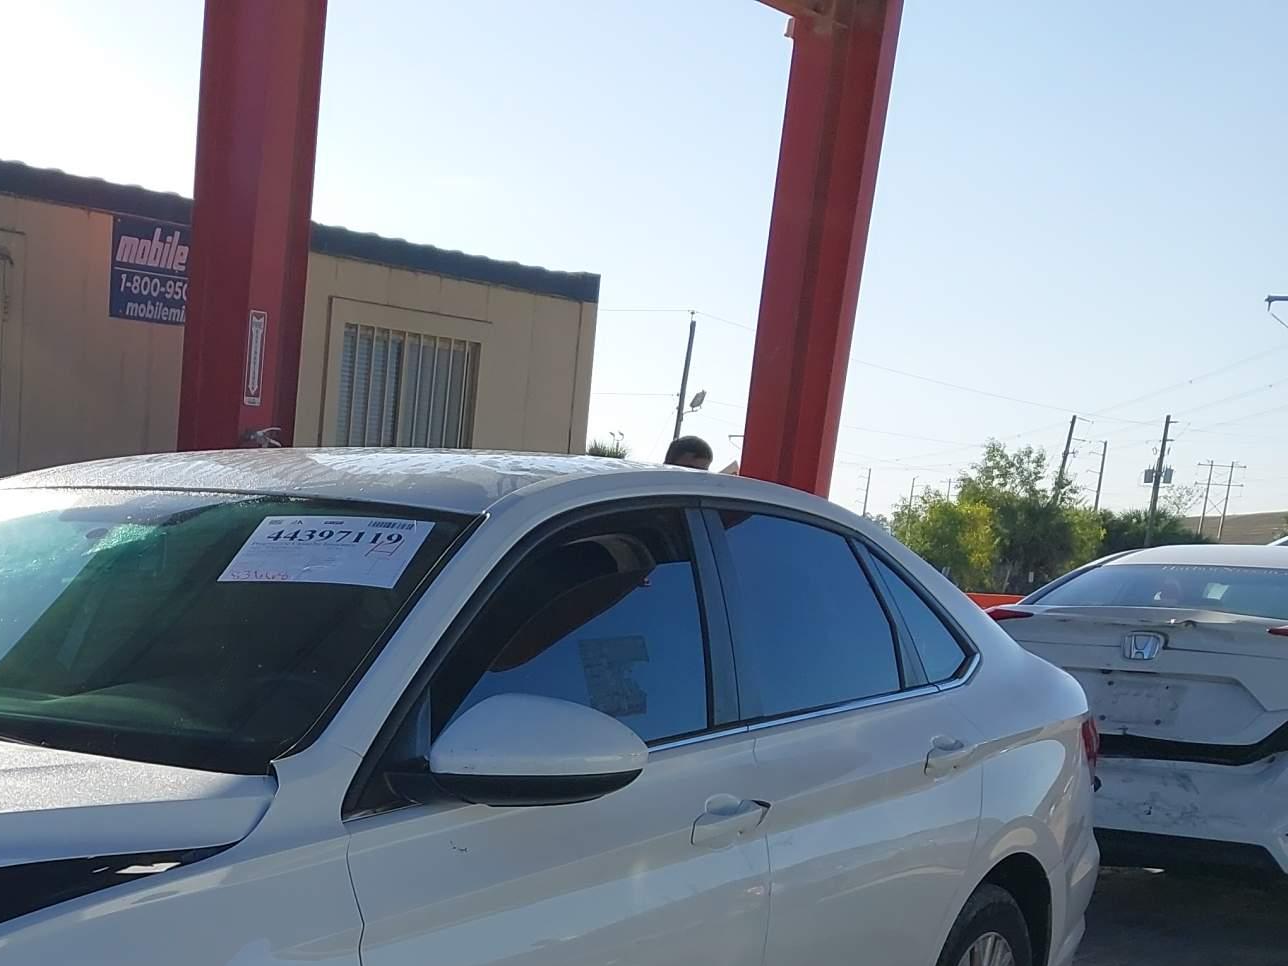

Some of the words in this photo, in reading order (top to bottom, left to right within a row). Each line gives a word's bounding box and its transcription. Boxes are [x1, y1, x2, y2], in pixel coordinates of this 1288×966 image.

[115, 226, 189, 272] mobile
[125, 300, 186, 323] mobilemi
[266, 528, 404, 545] 44397119
